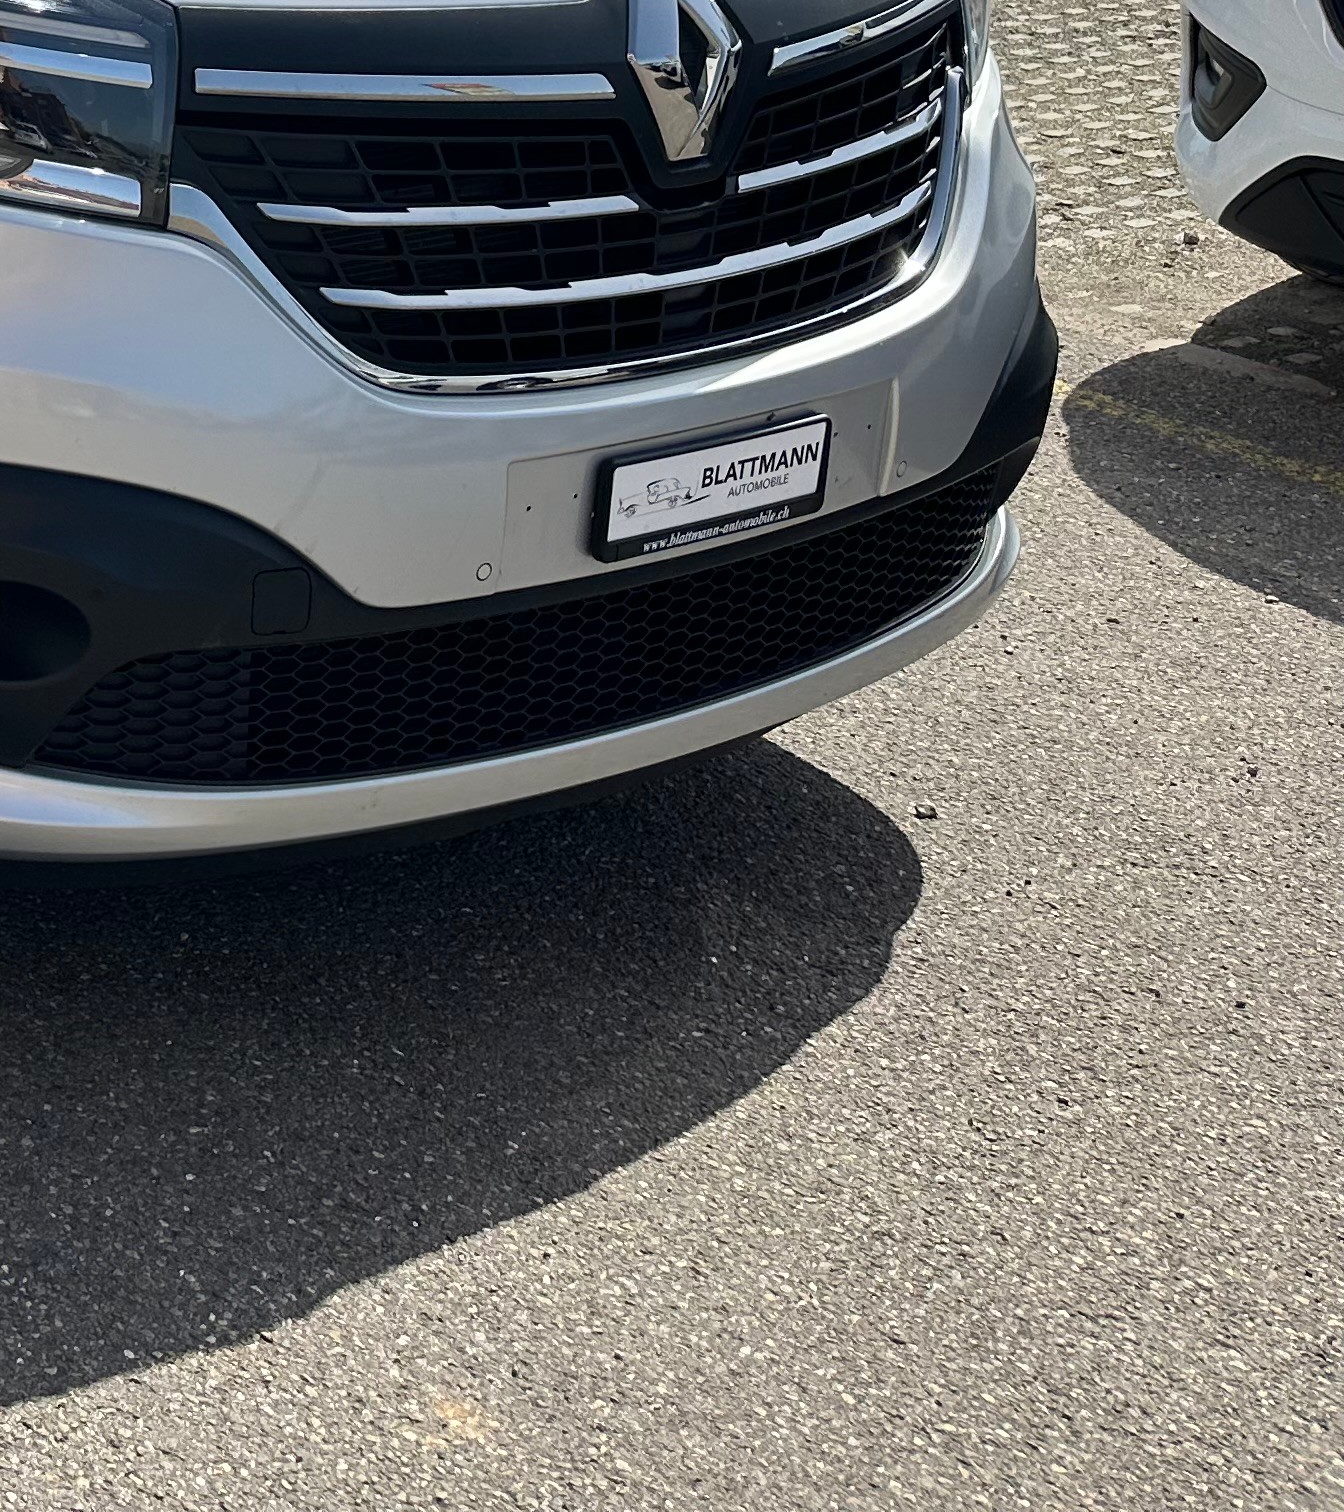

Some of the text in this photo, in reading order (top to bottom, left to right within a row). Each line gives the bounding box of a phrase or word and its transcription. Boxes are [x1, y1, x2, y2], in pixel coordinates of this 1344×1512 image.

[700, 441, 821, 489] BLATTMANN
[727, 472, 790, 498] AUTOMOBILE
[642, 505, 790, 553] www.blattmann-automobile.ch
